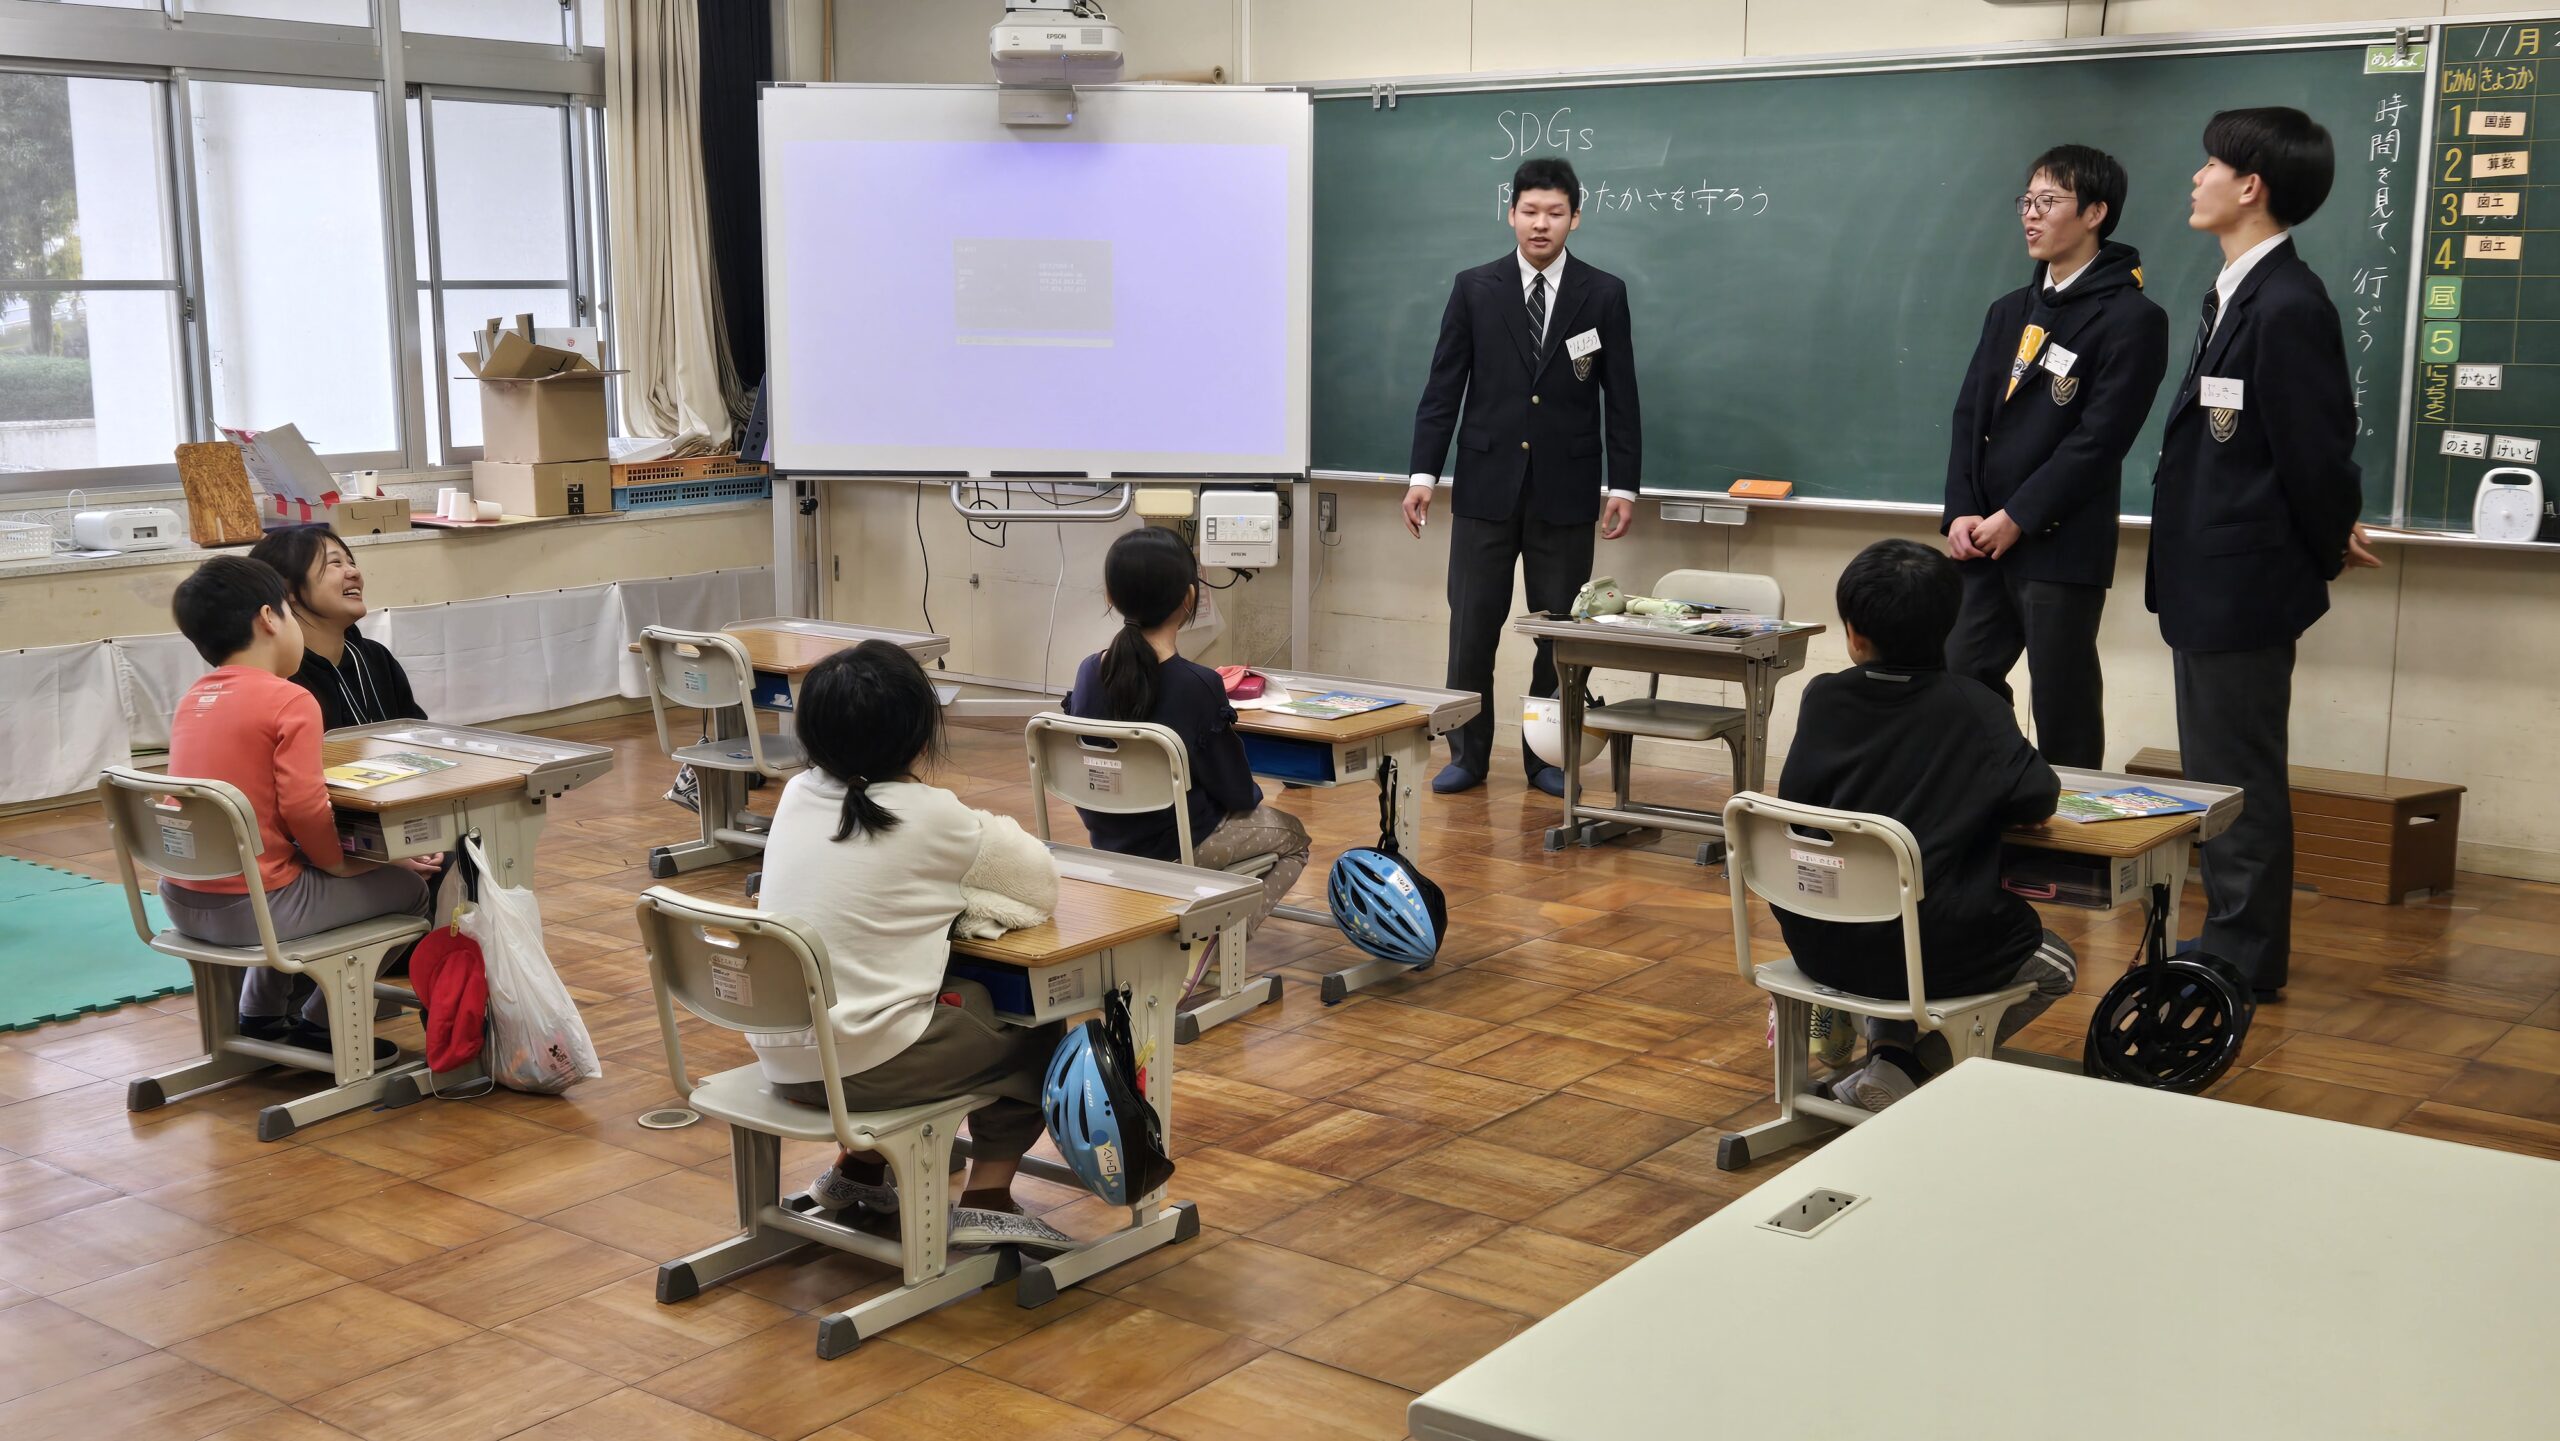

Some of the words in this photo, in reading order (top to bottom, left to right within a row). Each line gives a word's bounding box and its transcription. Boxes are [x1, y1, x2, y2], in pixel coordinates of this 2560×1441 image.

[2443, 67, 2477, 93] じかん
[2481, 66, 2534, 92] きょうか
[2449, 105, 2462, 137] 1
[2484, 115, 2512, 128] 国語
[1490, 107, 1594, 161] SDGs
[2445, 147, 2463, 182] 2
[2487, 156, 2516, 170] 算数
[2440, 193, 2458, 226] 3
[2477, 196, 2505, 208] 図工
[2434, 237, 2456, 270] 4
[2479, 240, 2507, 251] 図工
[2429, 286, 2456, 310] 昼
[2430, 330, 2454, 355] 5
[2460, 373, 2497, 386] かなと
[2446, 440, 2483, 455] のえる
[2497, 444, 2534, 460] けいと
